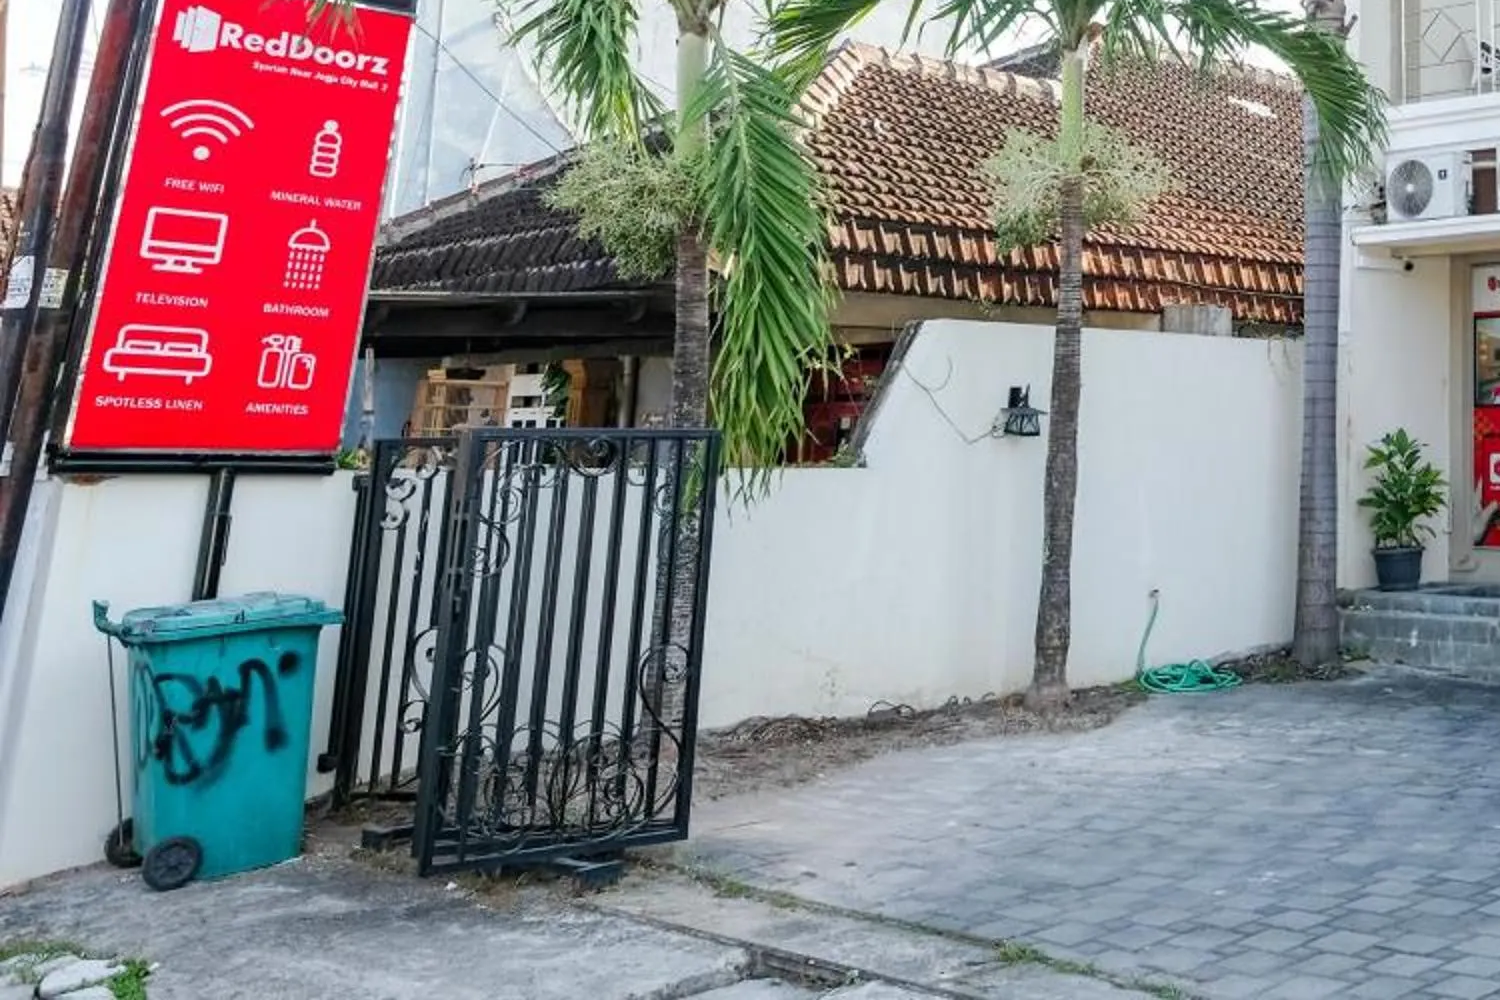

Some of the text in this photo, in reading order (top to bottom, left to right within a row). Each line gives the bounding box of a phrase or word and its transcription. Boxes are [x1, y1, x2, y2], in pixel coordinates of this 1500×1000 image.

[219, 21, 390, 76] RedDoorz
[340, 74, 358, 88] City
[164, 177, 225, 194] FREE WIFI
[270, 190, 362, 211] MINERAL WATER
[135, 292, 208, 308] TELEVISION
[263, 303, 330, 317] BATHROOM
[95, 395, 203, 412] SPOTLESS LINEN
[245, 402, 309, 416] AMENITIES
